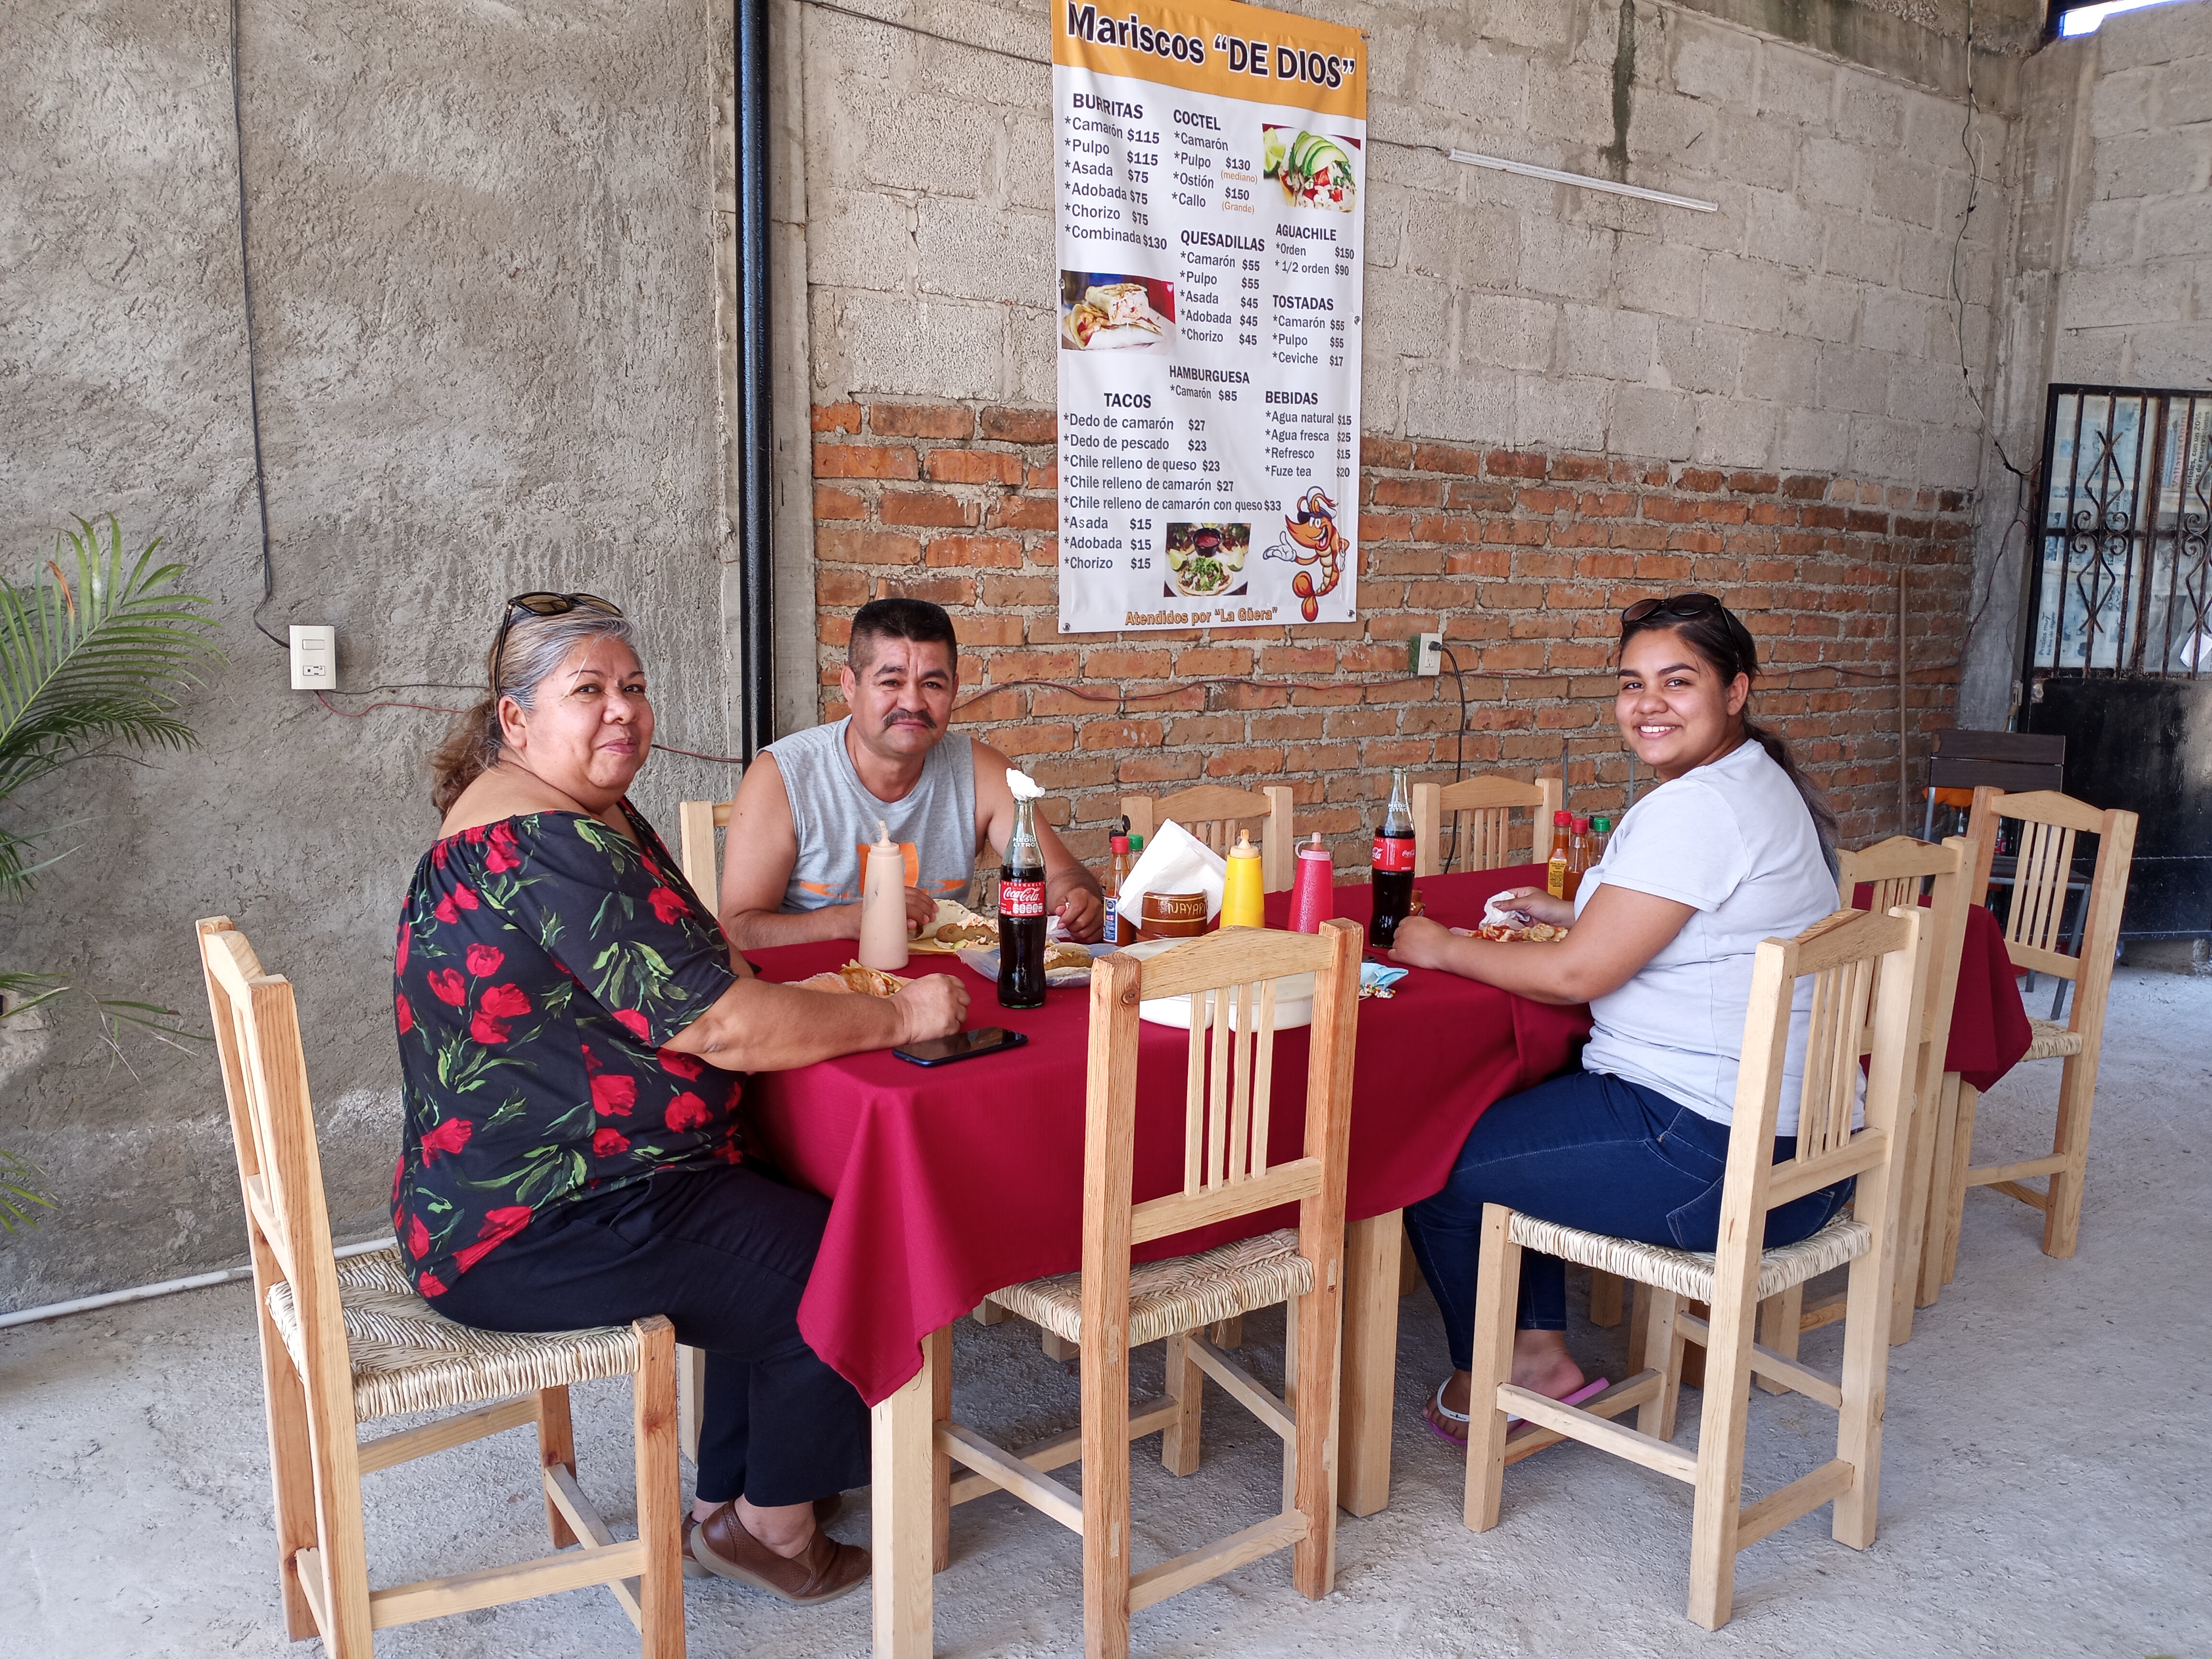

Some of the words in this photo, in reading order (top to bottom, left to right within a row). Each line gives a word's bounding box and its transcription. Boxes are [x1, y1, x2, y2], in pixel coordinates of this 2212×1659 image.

[1068, 1, 1205, 64] Mariscos
[1073, 94, 1143, 119] BURRITAS
[1173, 109, 1221, 131] COCTEL
[1127, 130, 1159, 144] $115
[1127, 152, 1158, 166] $115
[1226, 156, 1250, 171] $130
[1128, 169, 1149, 183] $75
[1221, 169, 1257, 184] (mediano)
[1130, 191, 1148, 205] $75
[1225, 187, 1249, 201] $150
[1222, 201, 1254, 215] (Grande)
[1132, 211, 1148, 226] $75
[1275, 223, 1336, 241] AGUACHILE
[1143, 234, 1167, 250] $130
[1181, 230, 1265, 252] QUESADILLAS
[1334, 246, 1355, 260] $150
[1242, 258, 1260, 272] $55
[1302, 262, 1329, 275] orden
[1334, 263, 1349, 276] $90
[1241, 276, 1260, 290] $55
[1240, 296, 1259, 309] $45
[1273, 295, 1334, 311] TOSTADAS
[1239, 314, 1258, 327] $45
[1330, 319, 1345, 331] $55
[1239, 334, 1257, 346] $45
[1330, 337, 1344, 349] $55
[1330, 355, 1344, 367] $17
[1169, 365, 1250, 384] HAMBURGUESA
[1104, 393, 1151, 409] TACOS
[1218, 390, 1237, 402] $85
[1265, 391, 1318, 405] BEBIDAS
[1104, 414, 1118, 428] de
[1122, 417, 1174, 430] camarón
[1188, 419, 1205, 432] $27
[1301, 412, 1334, 424] natural
[1338, 415, 1351, 426] $15
[1300, 430, 1329, 442] fresca
[1337, 432, 1351, 443] $25
[1104, 435, 1118, 448] de
[1122, 437, 1169, 452] pescado
[1188, 440, 1207, 453] $23
[1337, 449, 1350, 460] $15
[2186, 458, 2197, 488] Hoteles,
[2193, 433, 2199, 441] un
[1102, 456, 1142, 469] relleno
[1147, 457, 1159, 470] de
[1162, 461, 1197, 472] queso
[1202, 460, 1220, 473] $23
[2196, 464, 2202, 473] de
[1296, 466, 1311, 477] tea
[1336, 467, 1350, 478] $20
[1102, 476, 1142, 490] relleno
[1146, 477, 1159, 490] de
[1162, 478, 1211, 491] camarón
[1216, 480, 1233, 493] $27
[1103, 496, 1142, 510] relleno
[1145, 497, 1159, 510] de
[1162, 498, 1210, 511] camarón
[1214, 501, 1231, 511] con
[1235, 501, 1262, 513] queso
[1264, 499, 1281, 512] $33
[1130, 518, 1152, 530] $15
[1130, 539, 1151, 551] $15
[1130, 558, 1151, 570] $15
[1125, 610, 1188, 625] Atendidos
[1191, 613, 1211, 626] por
[1003, 887, 1041, 902] Coca-Cola
[1167, 902, 1206, 915] NAYARI
